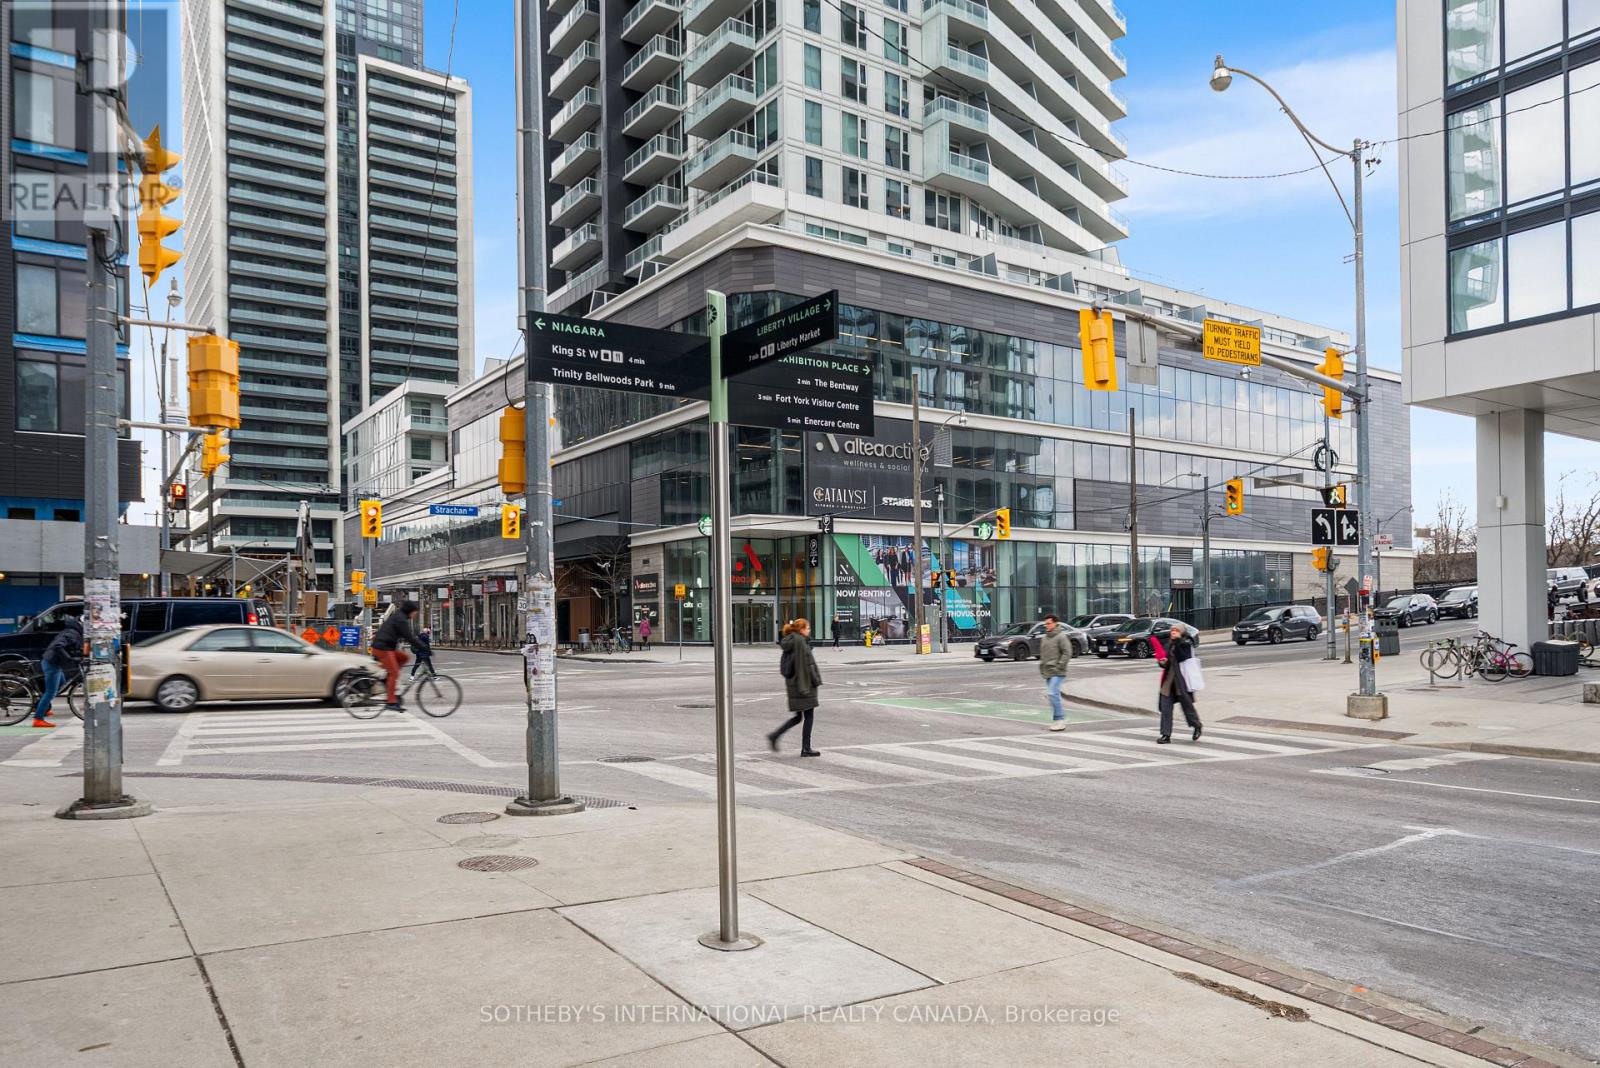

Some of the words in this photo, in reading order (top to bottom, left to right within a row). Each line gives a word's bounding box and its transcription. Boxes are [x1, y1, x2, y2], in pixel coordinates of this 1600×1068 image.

[757, 317, 786, 336] LIBERTY
[788, 304, 820, 324] VILLAGE
[552, 321, 605, 337] NIAGARA
[1206, 323, 1231, 335] TURNING
[1234, 328, 1258, 340] TRAFFIC
[776, 337, 798, 351] Liberty
[800, 328, 820, 342] Market
[1214, 336, 1230, 347] MUST
[1234, 339, 1250, 350] YIELD
[552, 345, 573, 357] King
[576, 348, 586, 358] St
[589, 350, 598, 359] W
[1207, 346, 1214, 355] TO
[1217, 348, 1258, 362] PEDESTRIANS
[832, 362, 858, 373] PLACE
[552, 368, 582, 381] Trinity
[586, 372, 632, 386] Bellwoods
[634, 377, 654, 388] Park
[814, 379, 828, 387] The
[829, 381, 859, 392] Bentway
[775, 394, 791, 403] Fort
[793, 396, 810, 405] York
[811, 399, 834, 408] Visitor
[836, 401, 860, 410] Centre
[804, 417, 835, 427] Enercare
[837, 421, 860, 430] Centre
[843, 460, 877, 469] wellness
[888, 464, 911, 472] social
[813, 486, 867, 505] CATALYST
[435, 506, 467, 515] Strachan
[836, 590, 856, 598] NOW
[858, 590, 891, 598] RENTING
